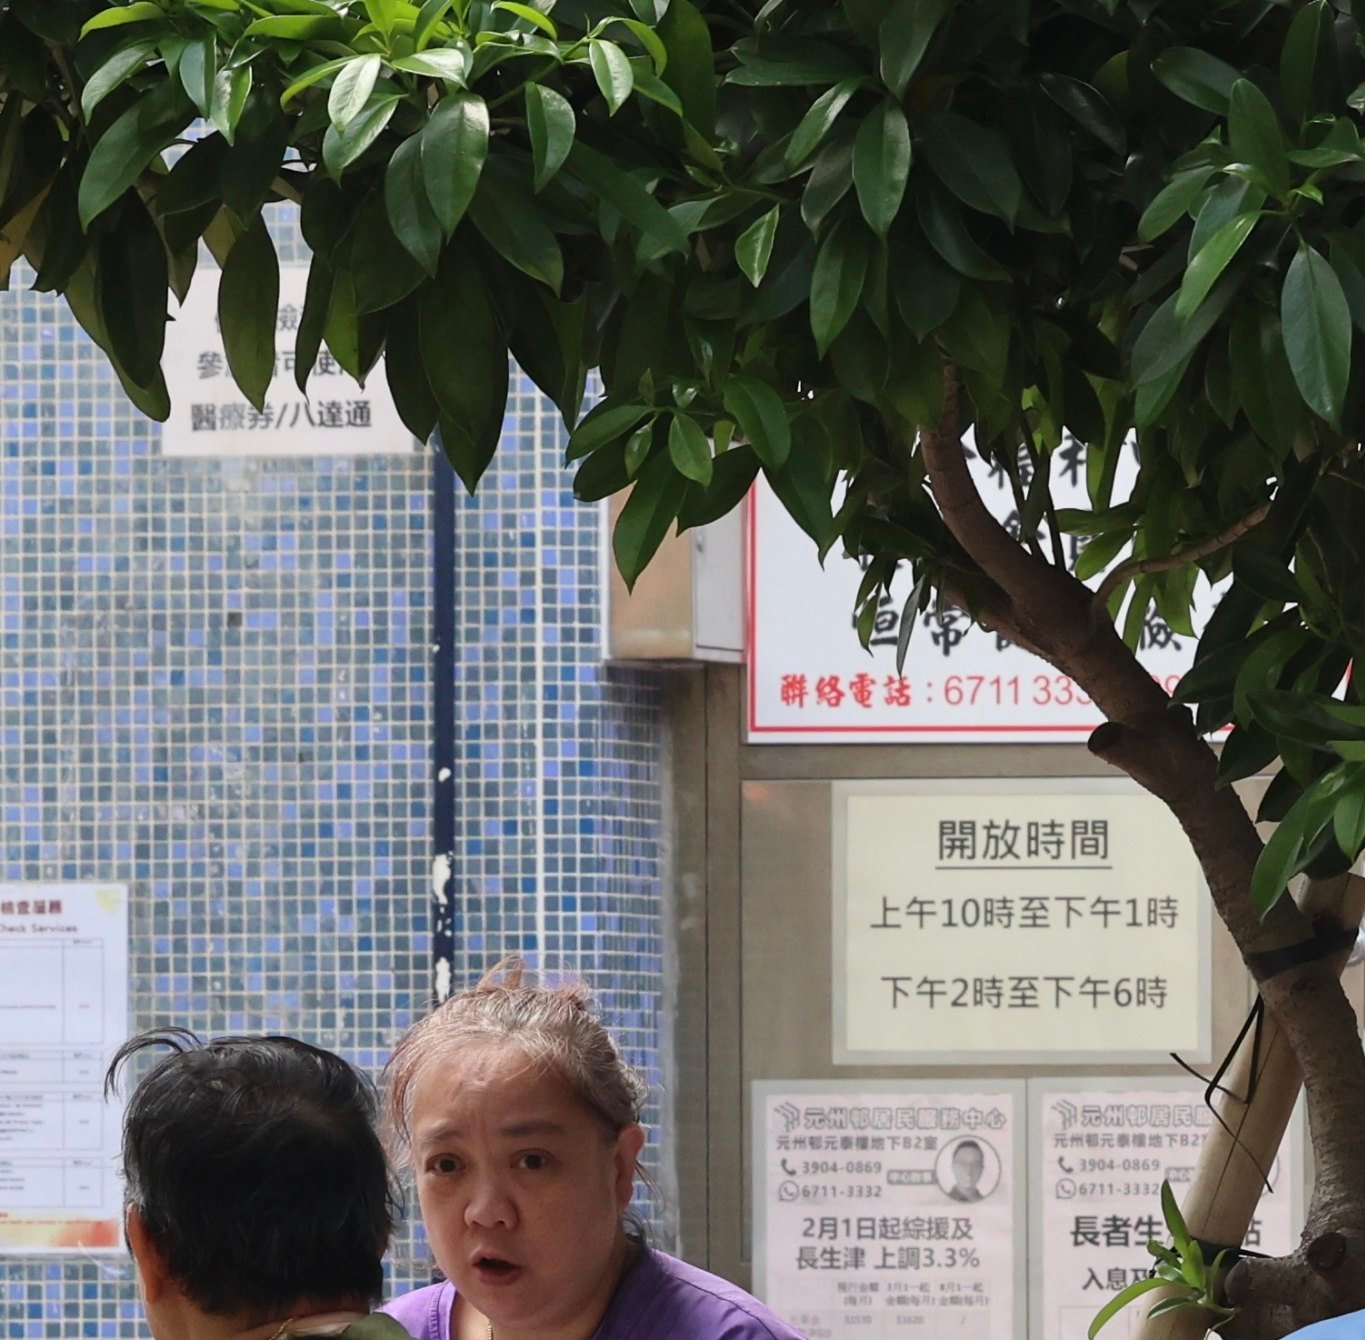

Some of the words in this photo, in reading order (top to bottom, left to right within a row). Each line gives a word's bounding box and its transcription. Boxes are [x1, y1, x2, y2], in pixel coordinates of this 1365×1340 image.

[943, 675, 1021, 705] 6711
[938, 818, 1110, 862] 開放時間
[870, 896, 1179, 931] 上午10時至下午1時
[881, 975, 1168, 1012] 下午2時至下午6時
[802, 1161, 882, 1175] 3904-0869
[1079, 1158, 1161, 1172] 3904-0869
[802, 1185, 882, 1199] 6711-3332
[1079, 1182, 1160, 1196] 6711-3332
[802, 1217, 973, 1241] 2月1日起綜援及
[796, 1246, 866, 1271] 長生津
[874, 1246, 981, 1271] 上調3.3%
